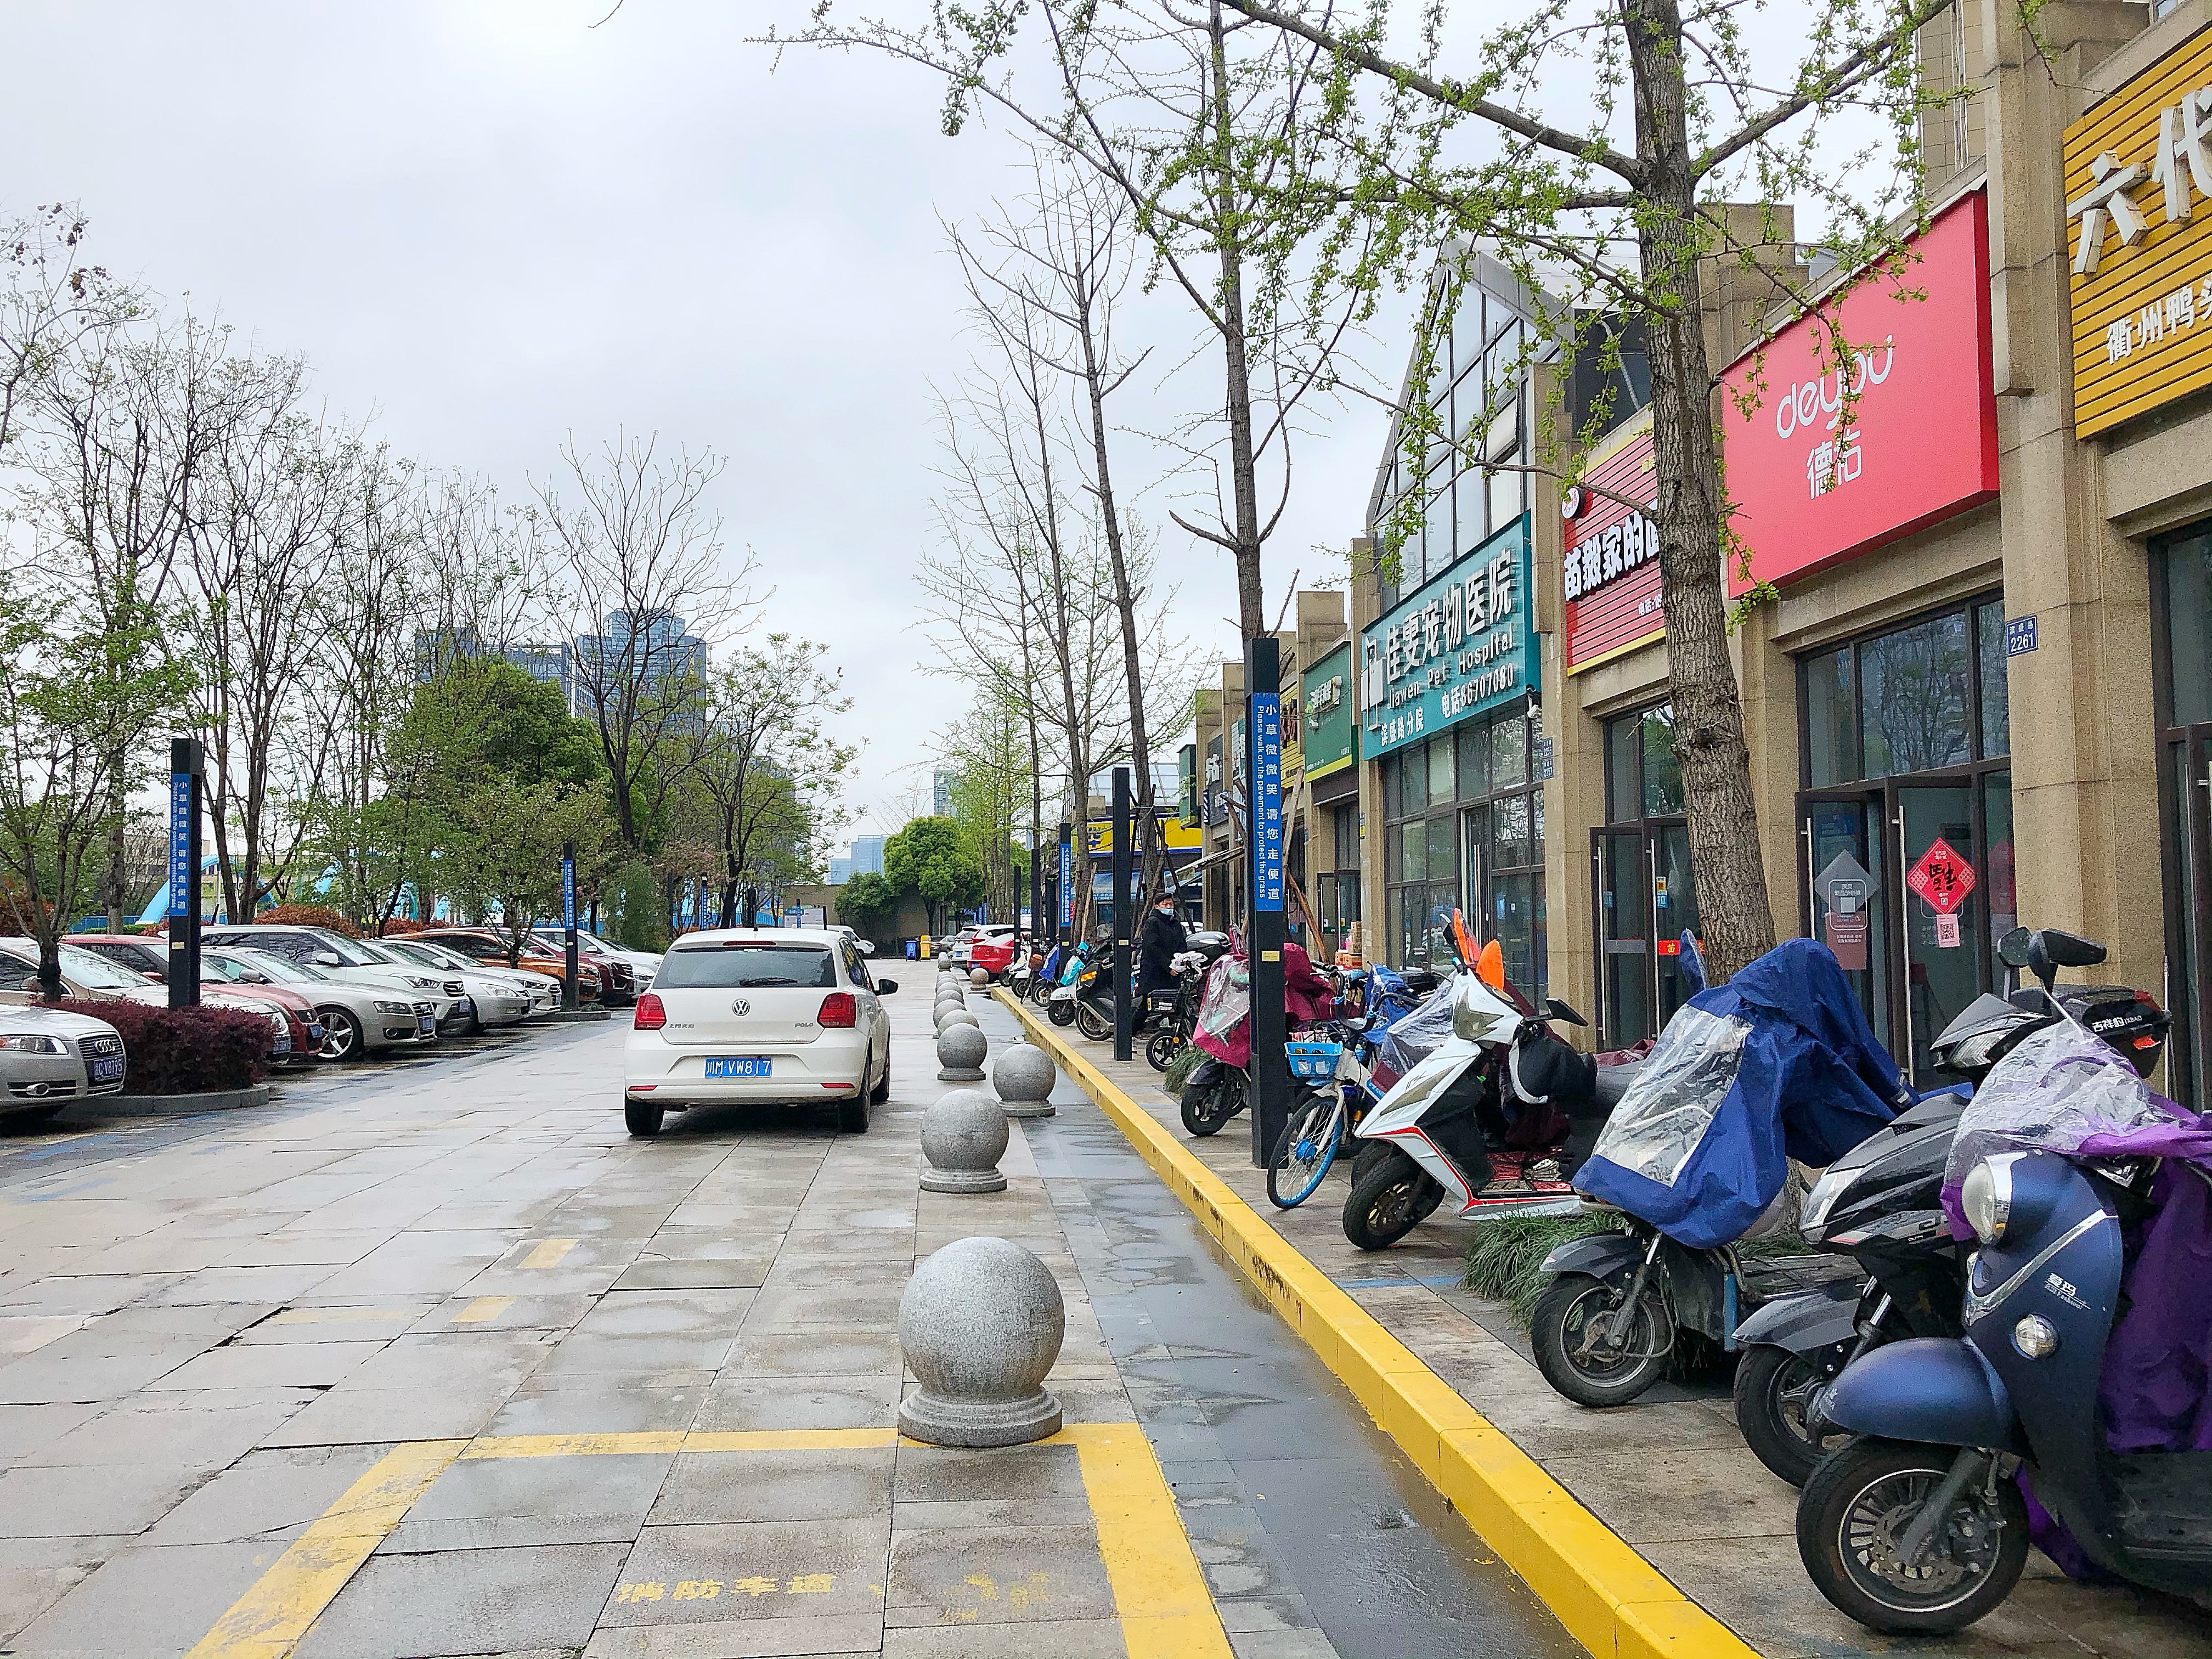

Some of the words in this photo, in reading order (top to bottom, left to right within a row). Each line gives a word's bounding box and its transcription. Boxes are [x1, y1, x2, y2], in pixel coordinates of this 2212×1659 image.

[1776, 334, 1894, 439] deyou
[1385, 548, 1511, 685] 佳雯宠物医院
[1428, 659, 1446, 690] Pet
[1458, 623, 1513, 675] Hospital
[2011, 632, 2033, 652] 2261
[1257, 754, 1263, 765] on
[1265, 704, 1278, 795] 小草微微笑
[1256, 781, 1265, 820] pavement
[1257, 831, 1266, 859] protect
[1259, 821, 1265, 830] to
[1266, 808, 1280, 900] 请您走便道
[615, 1573, 836, 1603] 消防车道
